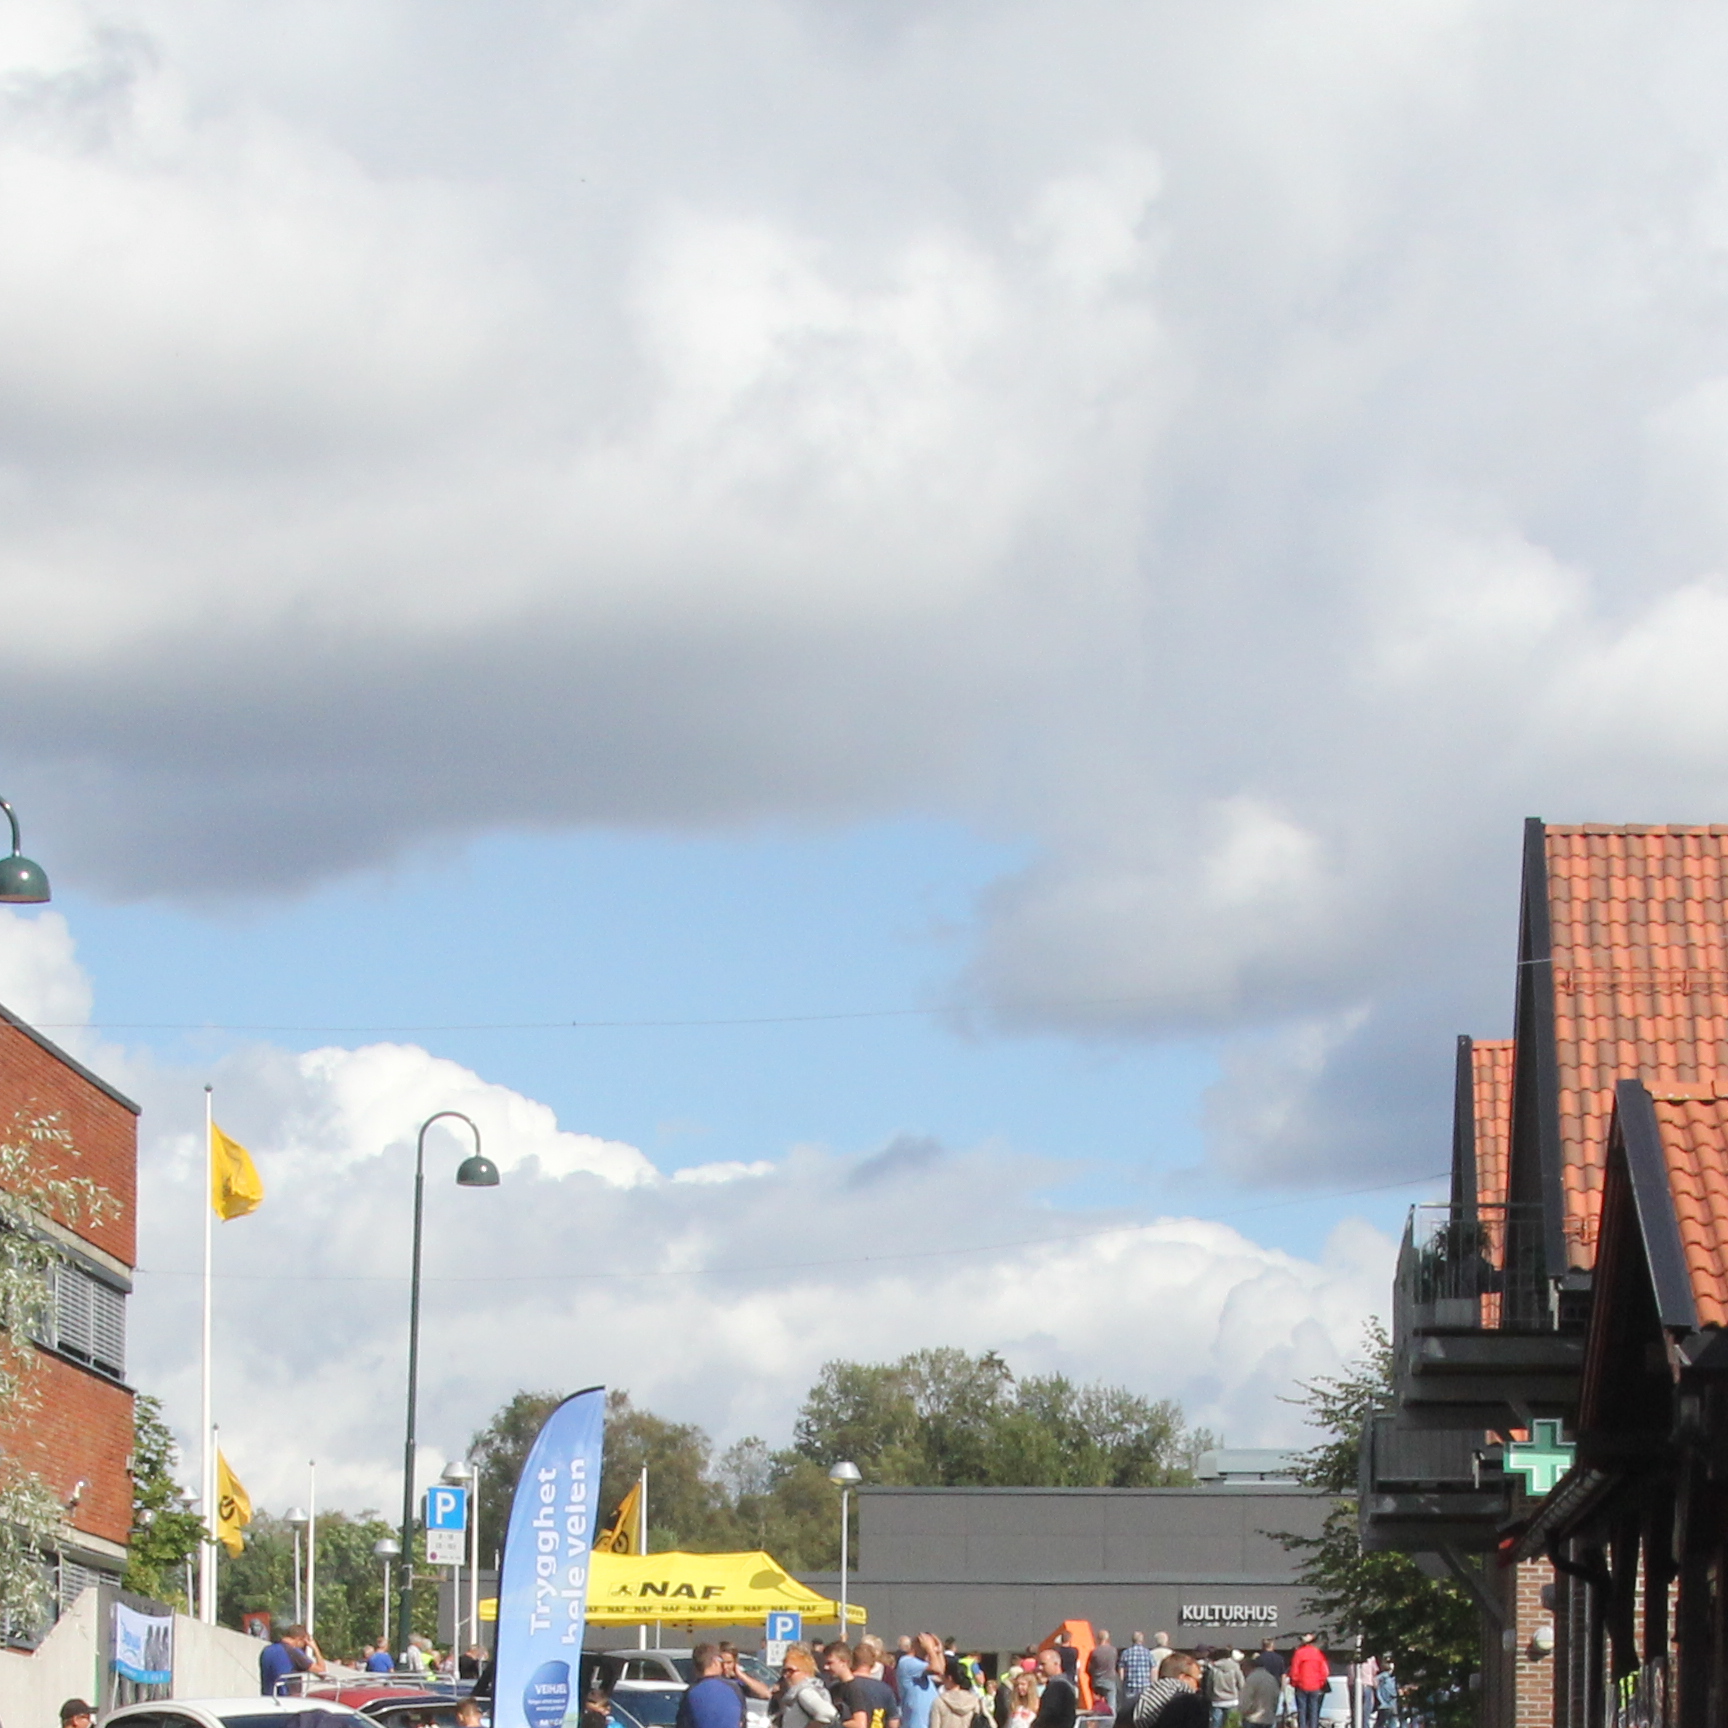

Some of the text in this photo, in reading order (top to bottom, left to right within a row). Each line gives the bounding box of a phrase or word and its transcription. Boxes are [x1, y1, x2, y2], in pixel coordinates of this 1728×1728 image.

[436, 1492, 456, 1525] P
[530, 1467, 560, 1636] Trygghet
[561, 1457, 588, 1645] hele veien
[639, 1581, 726, 1600] NAF
[607, 1605, 625, 1613] NAF
[634, 1605, 652, 1613] NAF
[662, 1605, 680, 1613] NAF
[689, 1605, 707, 1613] NAF
[716, 1605, 734, 1613] NAF
[743, 1605, 761, 1613] NAF
[771, 1605, 789, 1613] NAF
[798, 1605, 817, 1613] NAF
[1183, 1604, 1278, 1620] KULTURHUS
[776, 1616, 793, 1640] P
